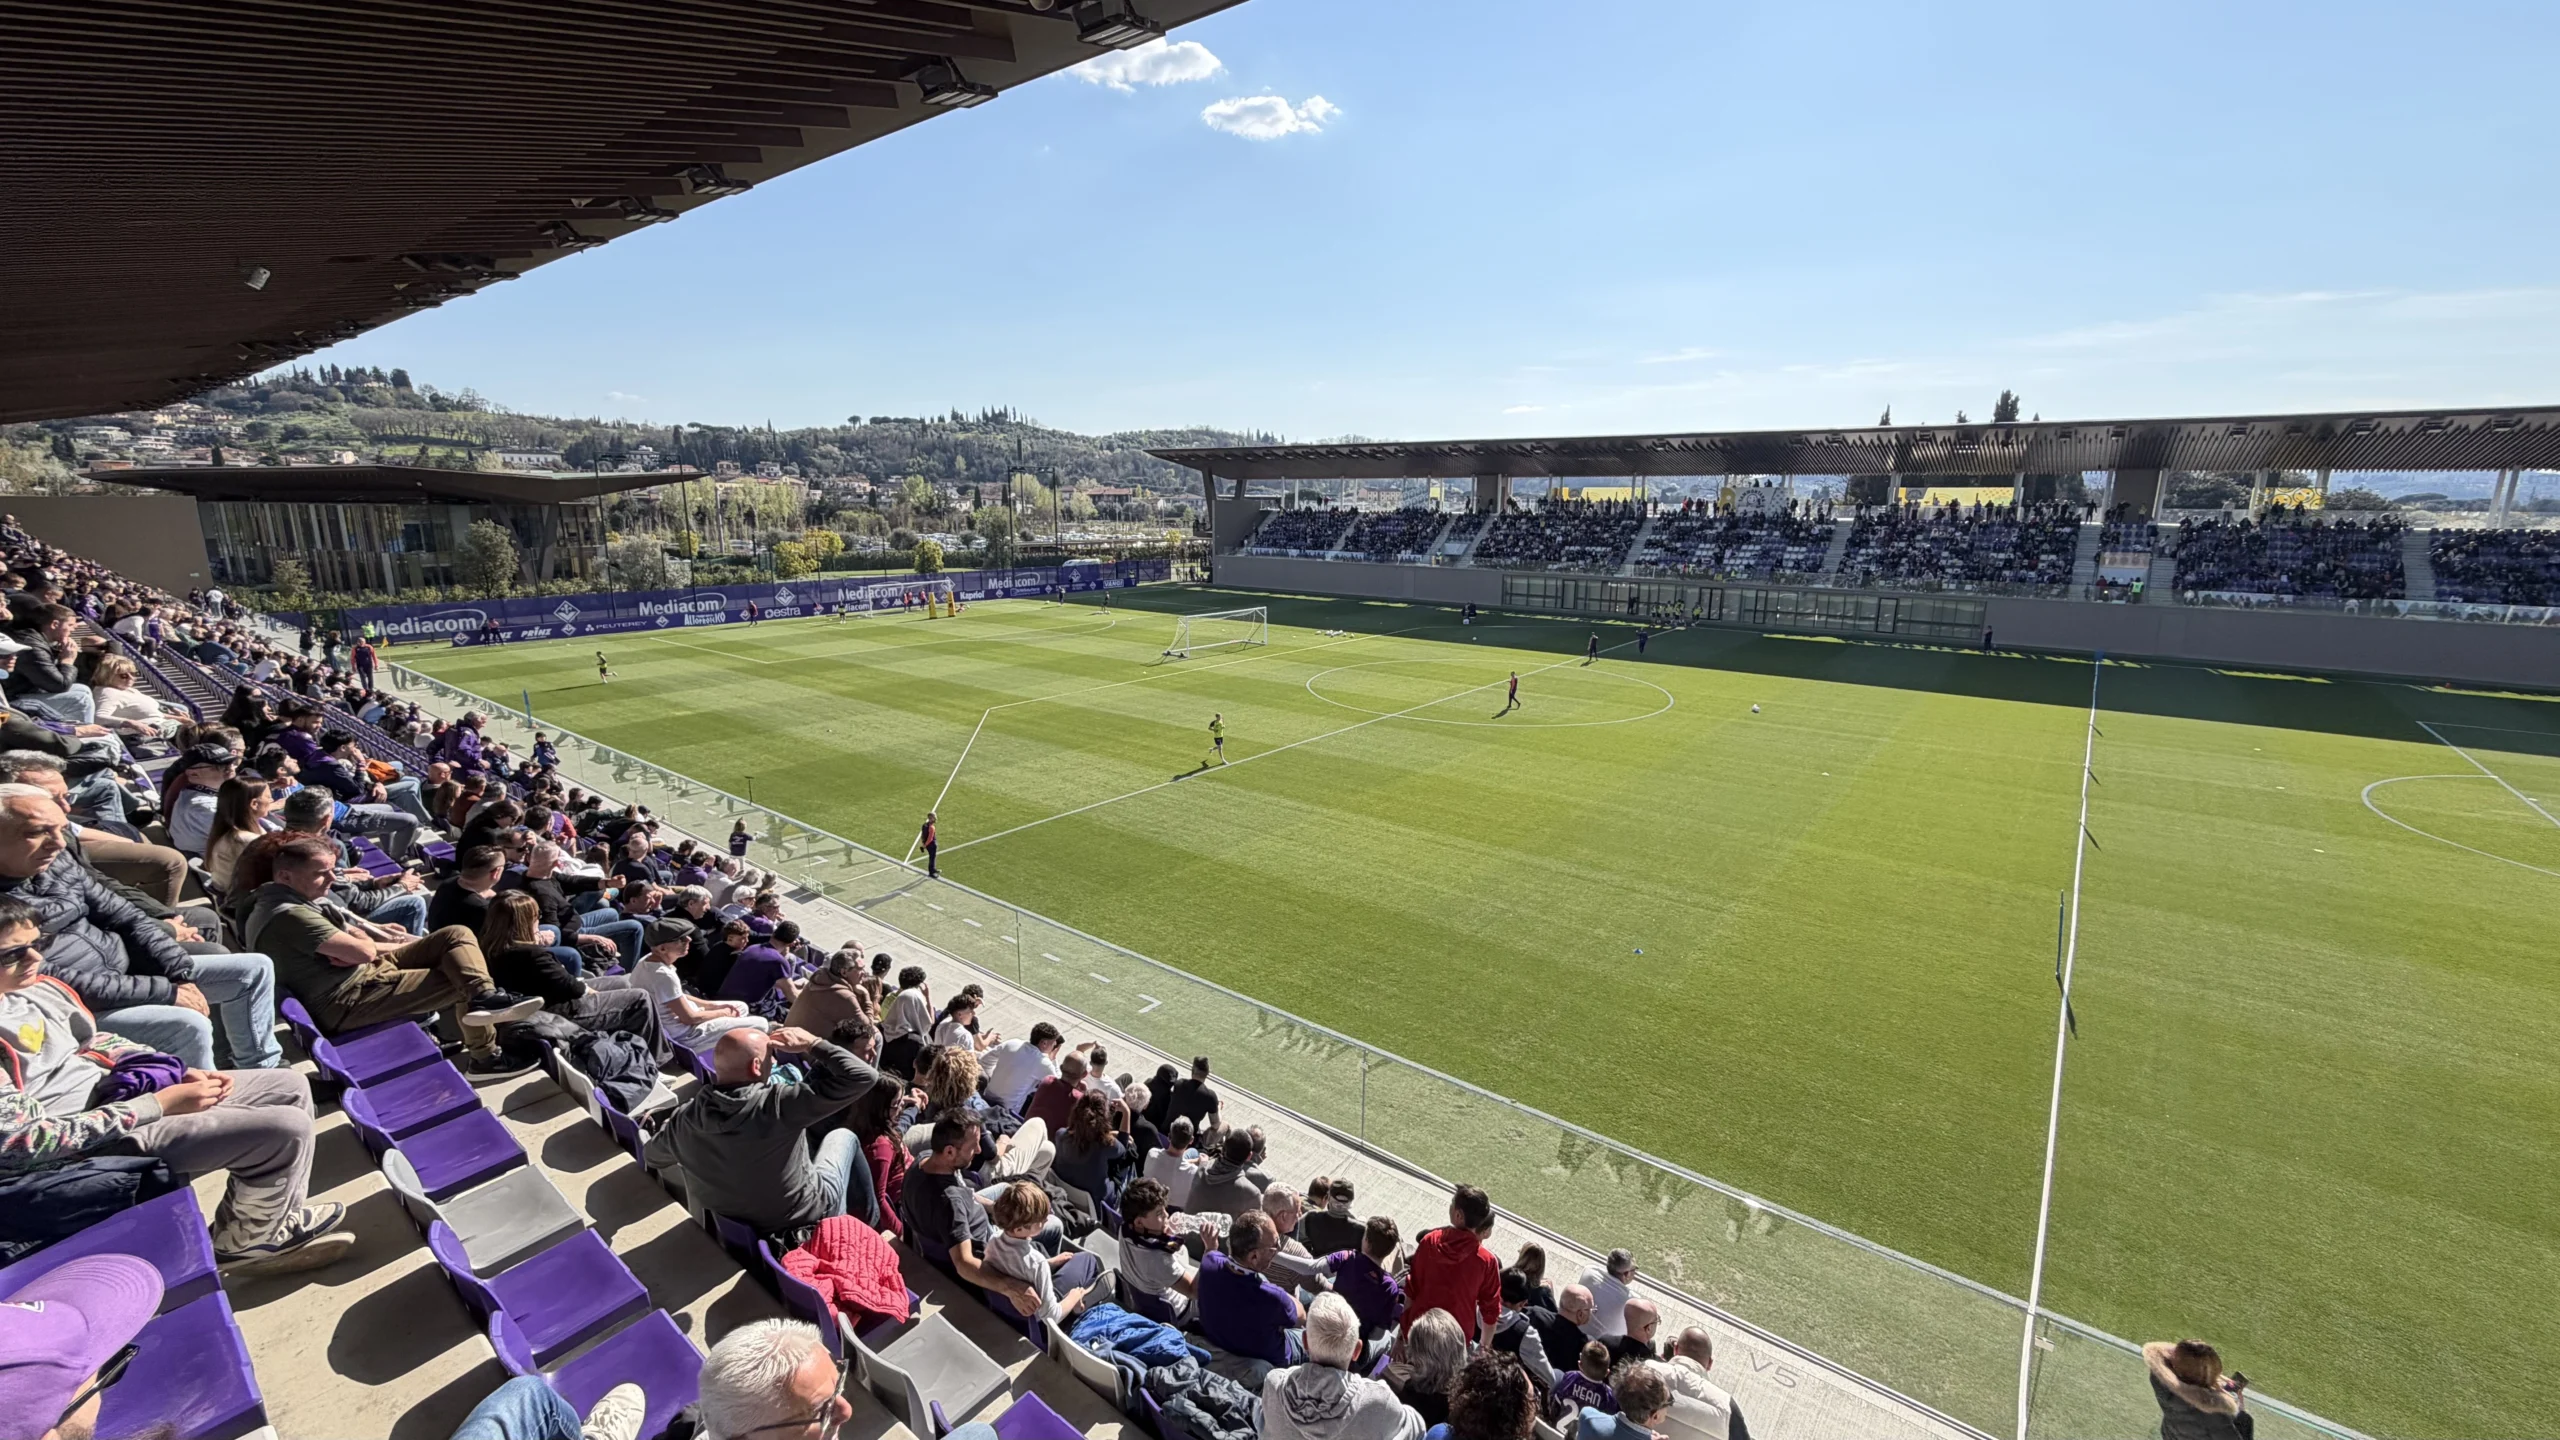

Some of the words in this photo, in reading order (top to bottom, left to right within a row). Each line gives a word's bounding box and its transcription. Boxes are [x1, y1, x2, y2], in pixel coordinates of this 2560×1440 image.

[838, 586, 898, 602] Mediacom
[960, 590, 985, 601] Kapriol
[639, 599, 719, 617] Mediacom
[831, 602, 870, 613] Mdiacom
[374, 616, 478, 637] Mediacom
[596, 620, 648, 630] PEUTEREY
[1749, 1351, 1800, 1389] V5
[1572, 1383, 1602, 1408] KEAN
